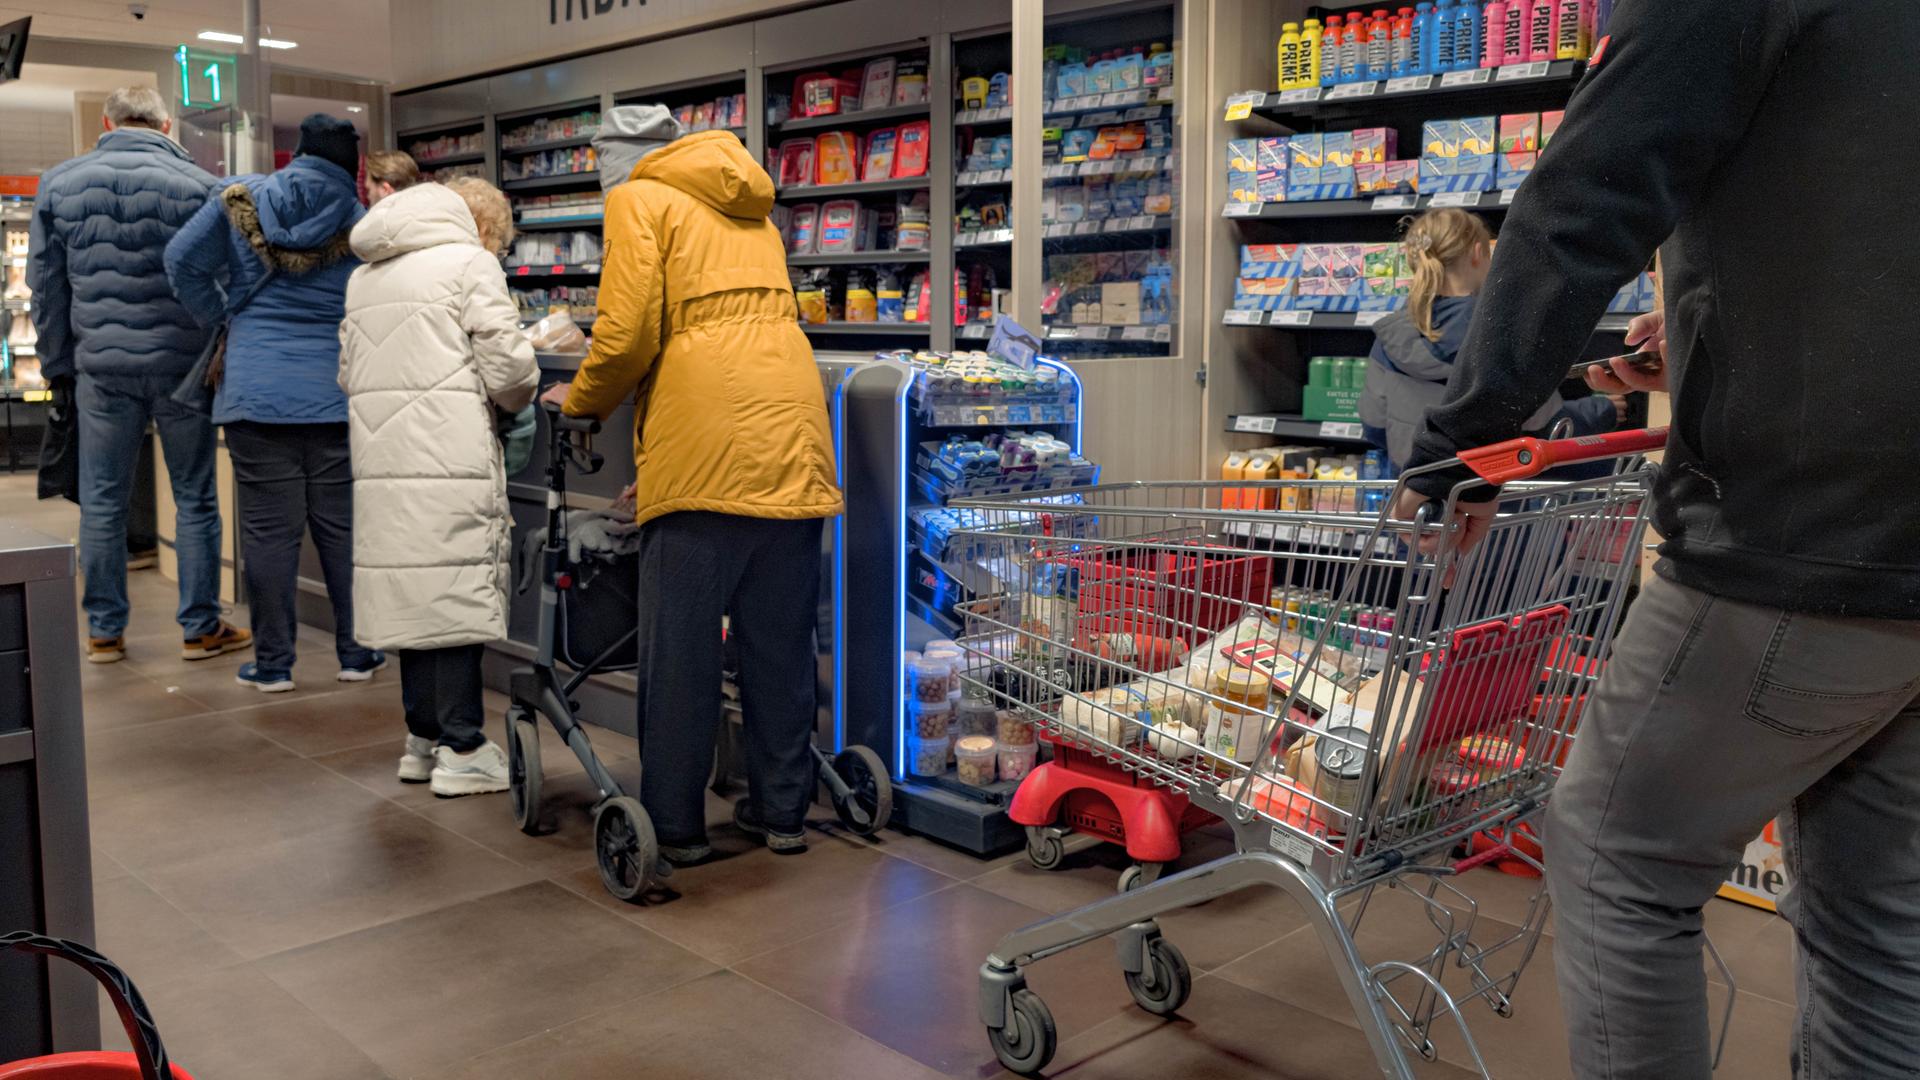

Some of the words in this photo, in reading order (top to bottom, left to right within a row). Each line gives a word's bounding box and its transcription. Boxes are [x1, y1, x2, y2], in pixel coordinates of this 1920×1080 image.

[1456, 18, 1472, 63] PRIME
[1504, 10, 1520, 56] PRIME
[1532, 6, 1550, 54] PRIME
[1560, 2, 1578, 52] PRIME
[204, 63, 220, 101] 1
[1282, 43, 1297, 84] PRIME
[1299, 40, 1311, 80] PRIME
